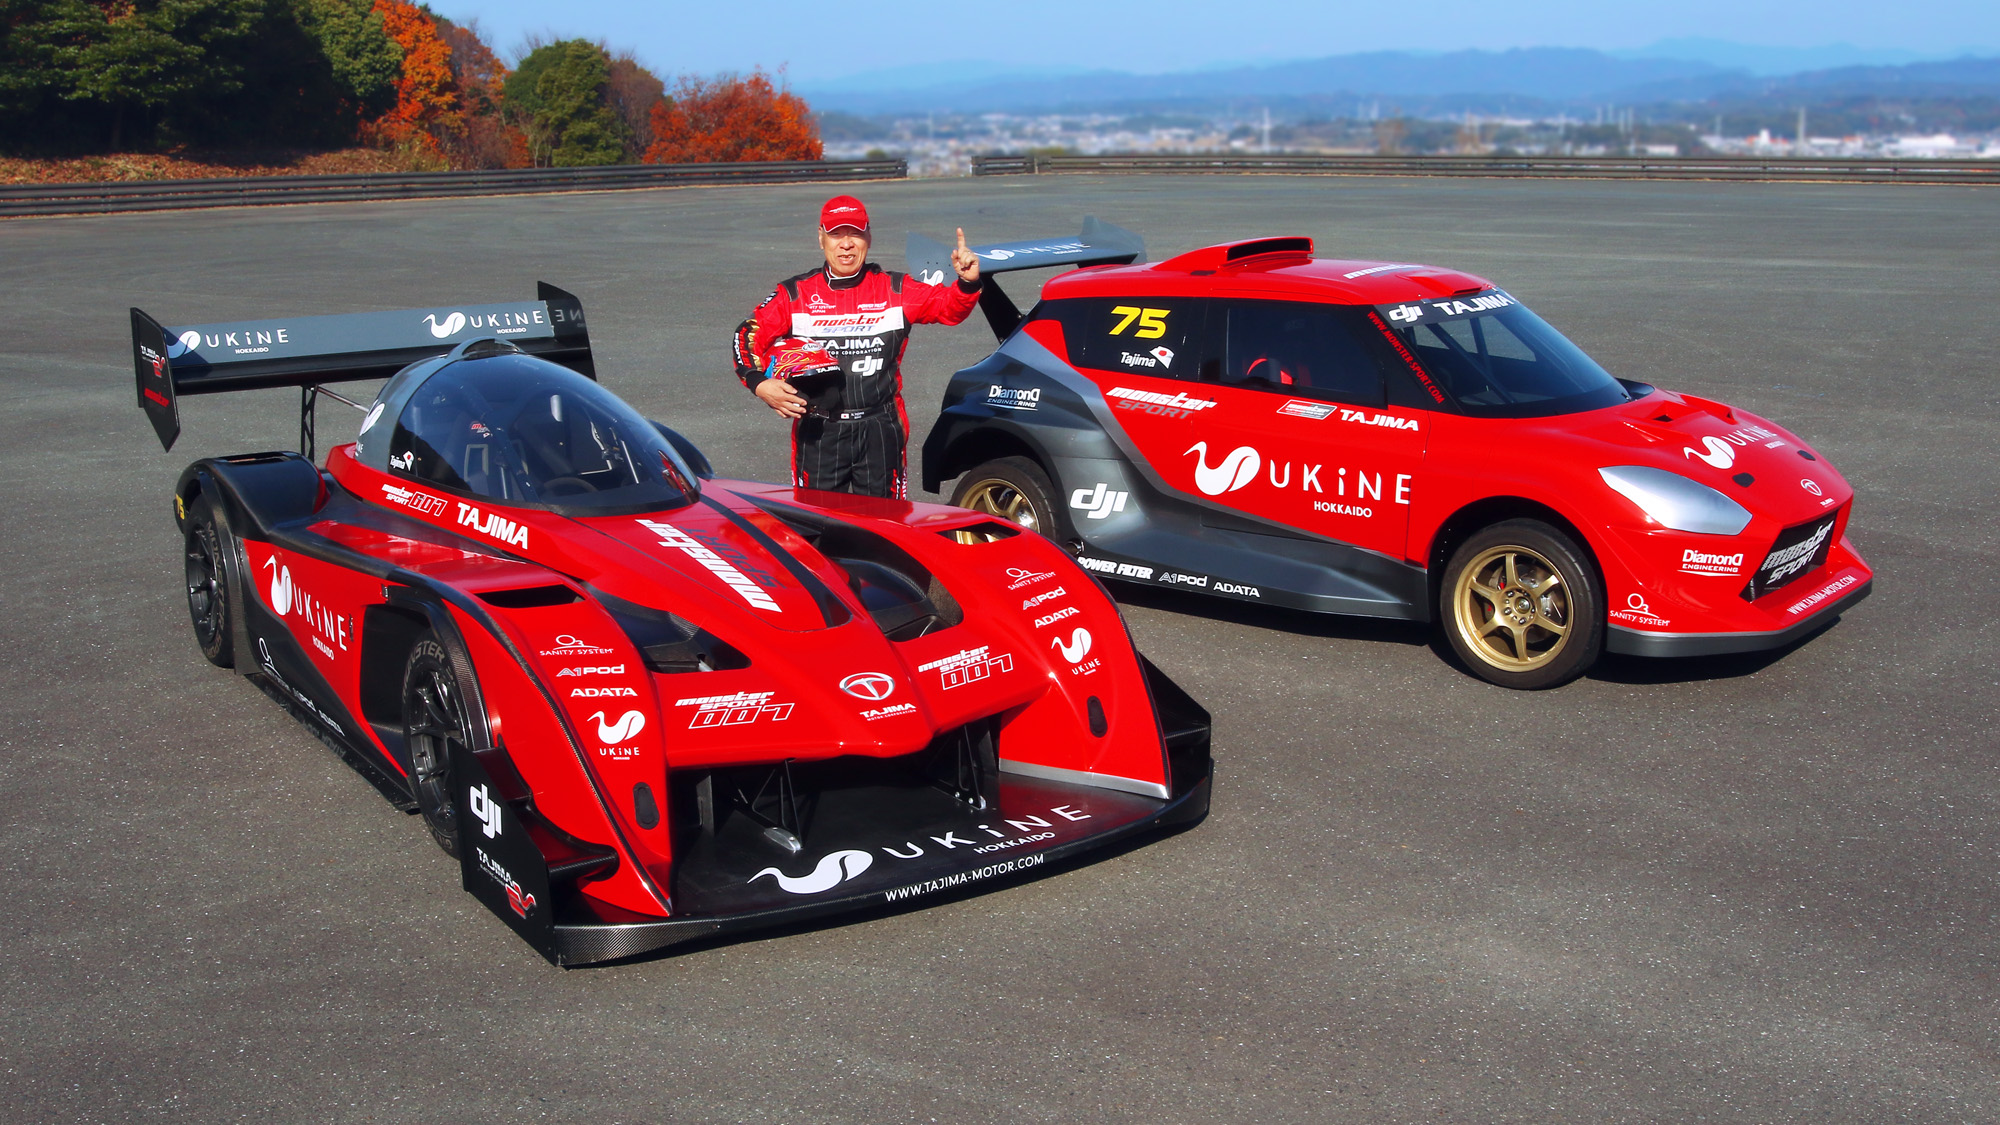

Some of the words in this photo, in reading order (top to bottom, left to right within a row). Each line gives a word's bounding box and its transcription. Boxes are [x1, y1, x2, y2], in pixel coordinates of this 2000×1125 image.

[1432, 294, 1515, 316] TAJIMA
[812, 315, 885, 327] monster
[821, 325, 876, 335] SPORT
[1108, 305, 1171, 339] 75
[817, 336, 885, 350] TAJIMA
[841, 347, 882, 356] CORPORATION
[1120, 351, 1157, 368] Tajima
[1367, 311, 1446, 404] WWW.MONSTER-SPORT.COM
[1106, 386, 1218, 411] monster
[1116, 400, 1194, 420] SPORT
[1340, 408, 1419, 431] TAJIMA
[381, 483, 414, 499] monster
[386, 492, 410, 508] SPORT
[1313, 501, 1372, 518] HOKKAIDO
[456, 501, 528, 550] TAJIMA
[679, 525, 787, 589] SPORT
[1761, 520, 1834, 572] monster
[634, 519, 783, 613] monster
[1682, 563, 1739, 574] ENGINEERING
[1766, 544, 1820, 585] SPORT
[1007, 578, 1032, 591] SANITY
[1031, 571, 1057, 584] SYSTEM
[1117, 562, 1154, 579] FILTER
[1213, 581, 1261, 598] ADATA
[1787, 574, 1857, 615] WWW.TAJIMA-MOTOR.COM
[1034, 606, 1080, 629] ADATA
[1610, 610, 1637, 623] SANITY
[1639, 616, 1670, 627] SYSTEM
[577, 648, 614, 656] SYSTEM
[918, 645, 989, 673] monster
[940, 652, 991, 674] SPORT
[941, 653, 1014, 690] 007
[570, 688, 638, 697] ADATA
[675, 691, 775, 707] monster
[698, 698, 771, 711] SPORT
[860, 703, 917, 719] TAJIMA
[688, 702, 796, 730] 007
[973, 831, 1056, 855] HOKKAIDO
[476, 846, 513, 888] TAJIMA
[885, 853, 1045, 902] WWW.TAJIMA-MOTOR.COM
